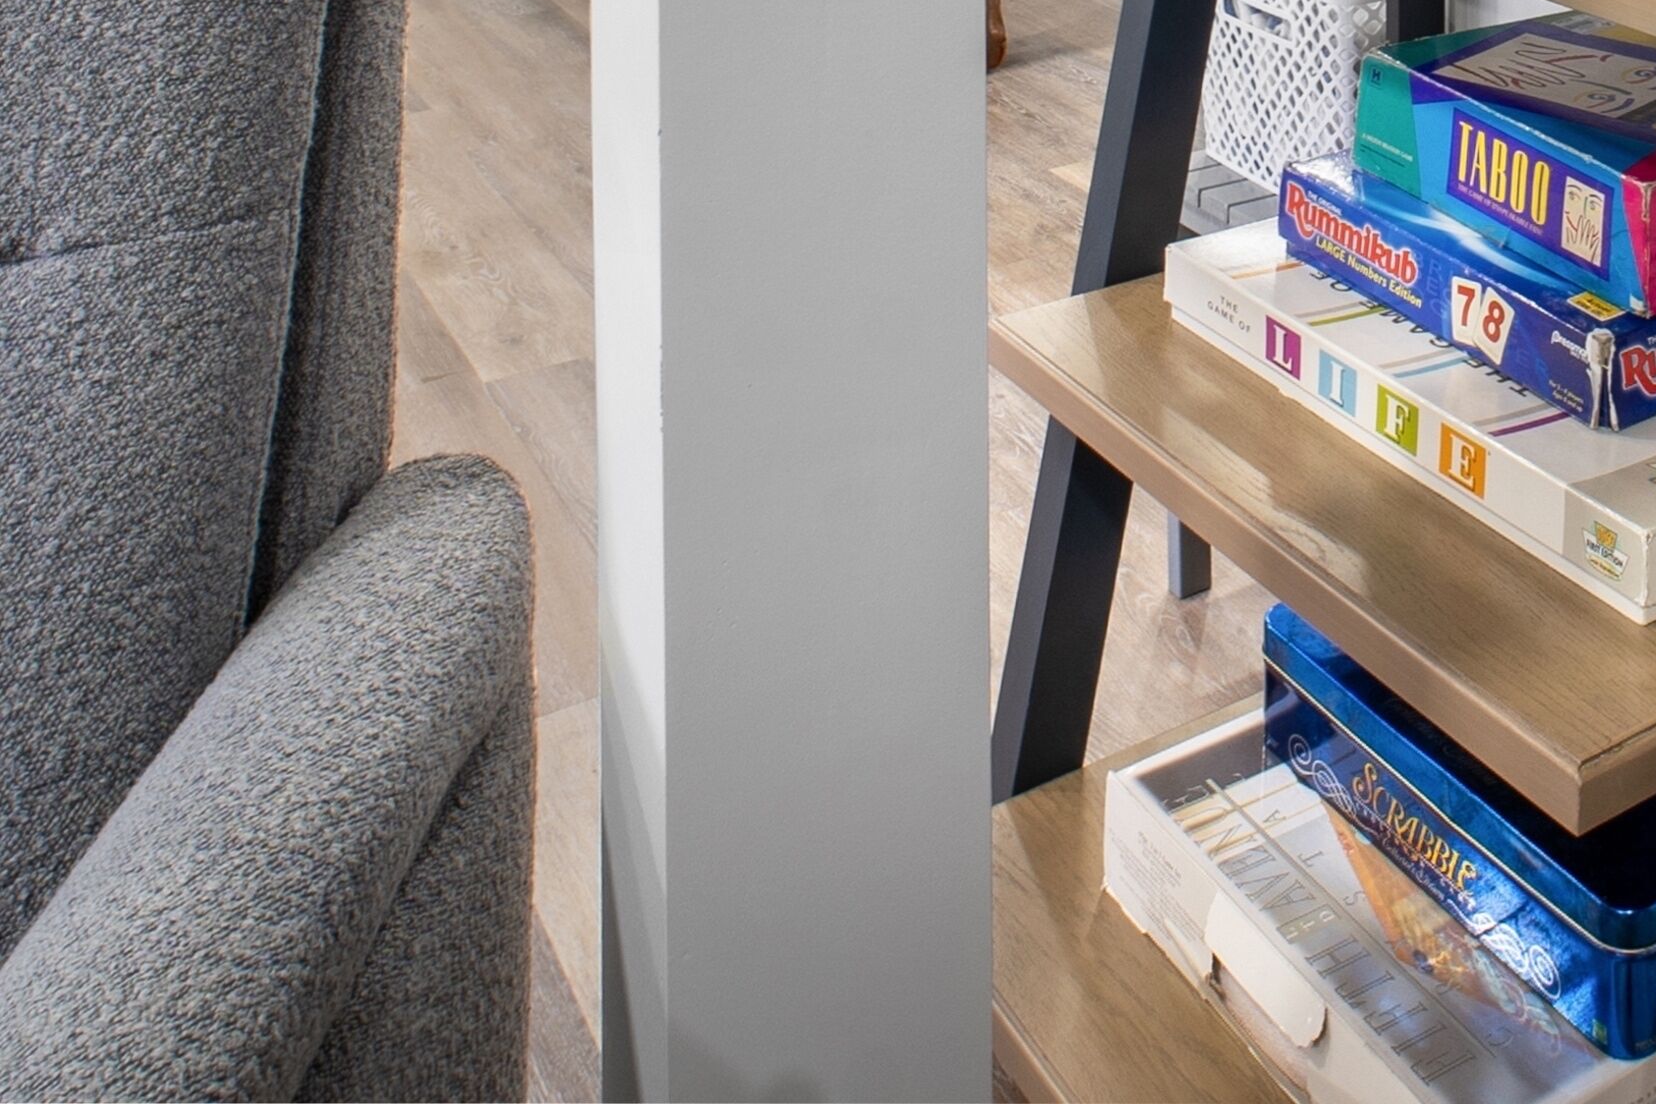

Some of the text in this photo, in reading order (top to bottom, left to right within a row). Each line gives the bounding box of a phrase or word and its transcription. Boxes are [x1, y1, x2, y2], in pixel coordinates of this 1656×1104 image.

[1307, 190, 1342, 215] THE ORIGINAL
[1458, 120, 1550, 226] TABOO
[1286, 181, 1418, 287] Rummikub
[1219, 295, 1240, 314] THE
[1316, 235, 1422, 308] LARGE Numbers Edition
[1207, 301, 1251, 334] GAME OF
[1457, 284, 1505, 344] 7 8
[1352, 762, 1478, 890] SCRABBLE
[1304, 934, 1477, 1087] FIFTH
